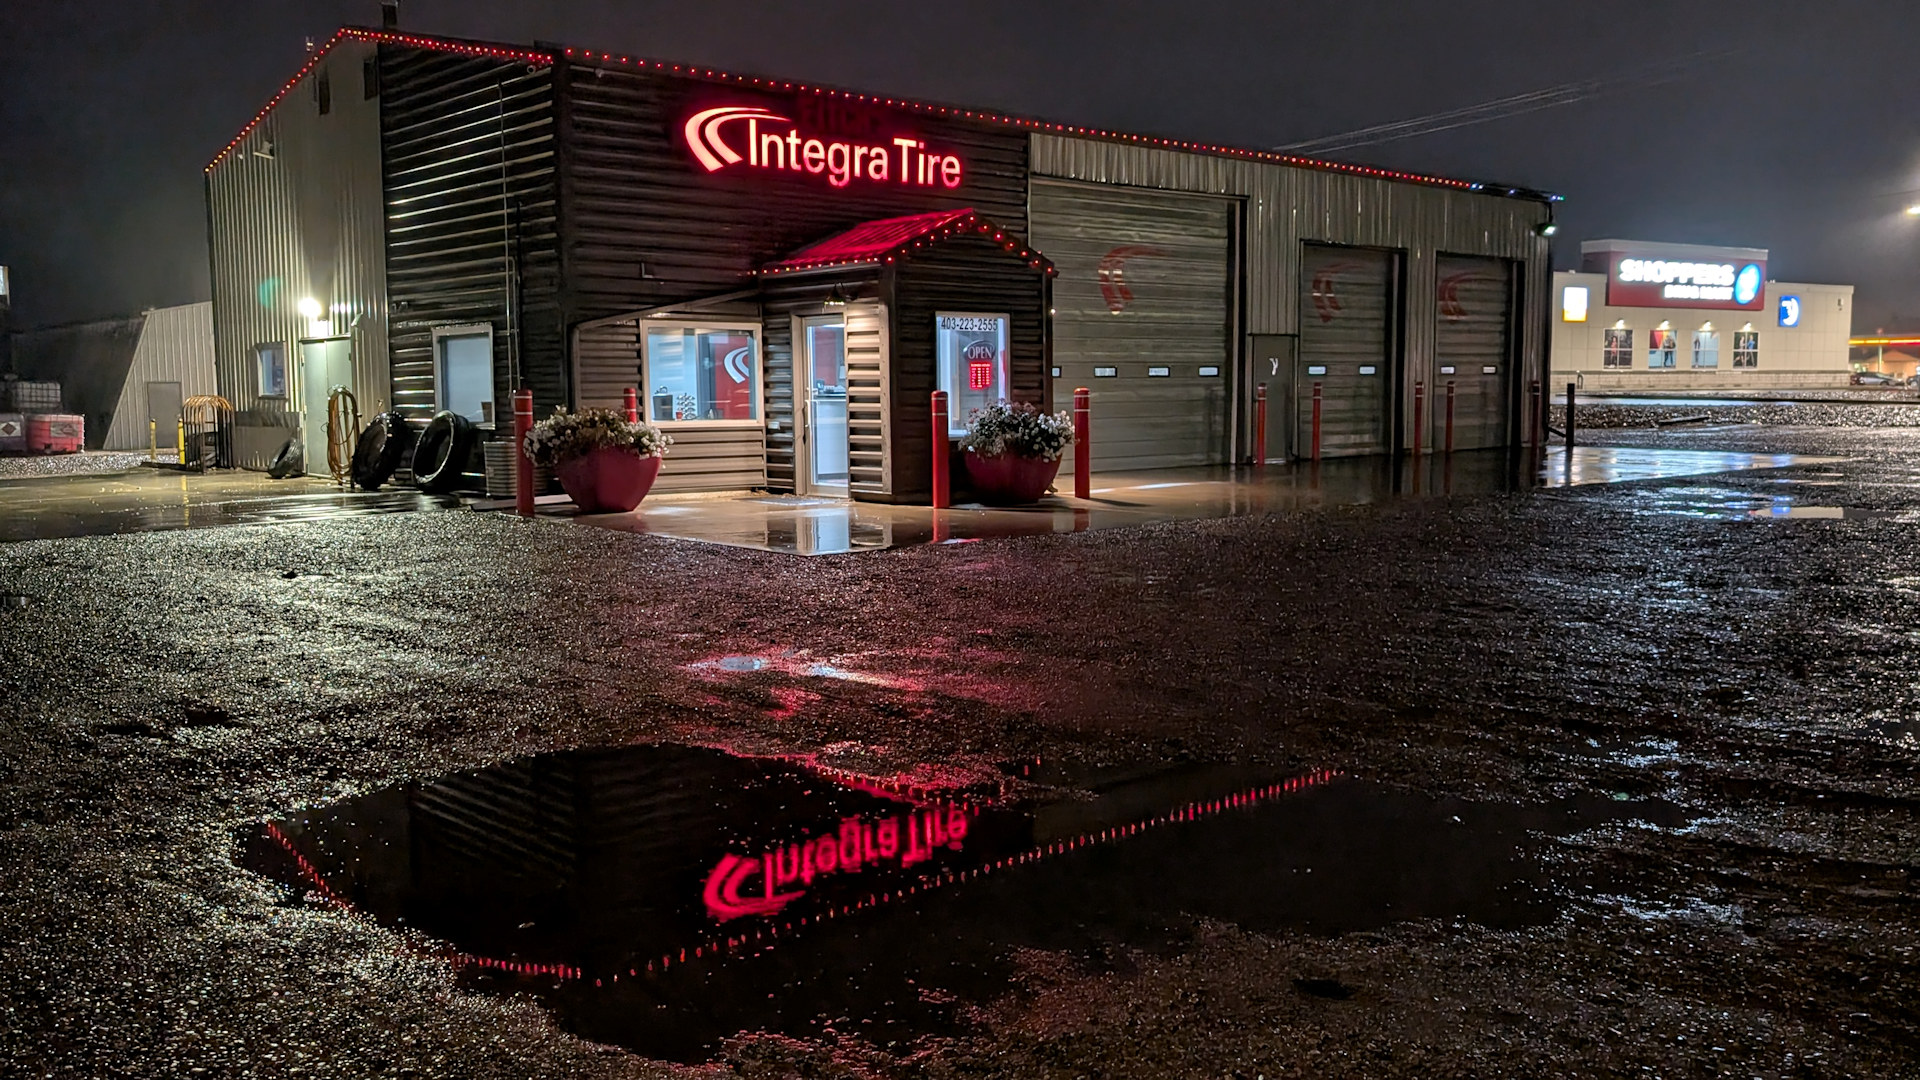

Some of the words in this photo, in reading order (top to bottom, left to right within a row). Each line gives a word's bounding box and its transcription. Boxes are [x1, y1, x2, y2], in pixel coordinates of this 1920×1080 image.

[749, 118, 888, 187] Integra
[893, 137, 961, 188] Tire
[1619, 258, 1735, 286] SHOPPERS
[941, 318, 997, 330] 403-223-2555
[968, 347, 992, 359] OPEN
